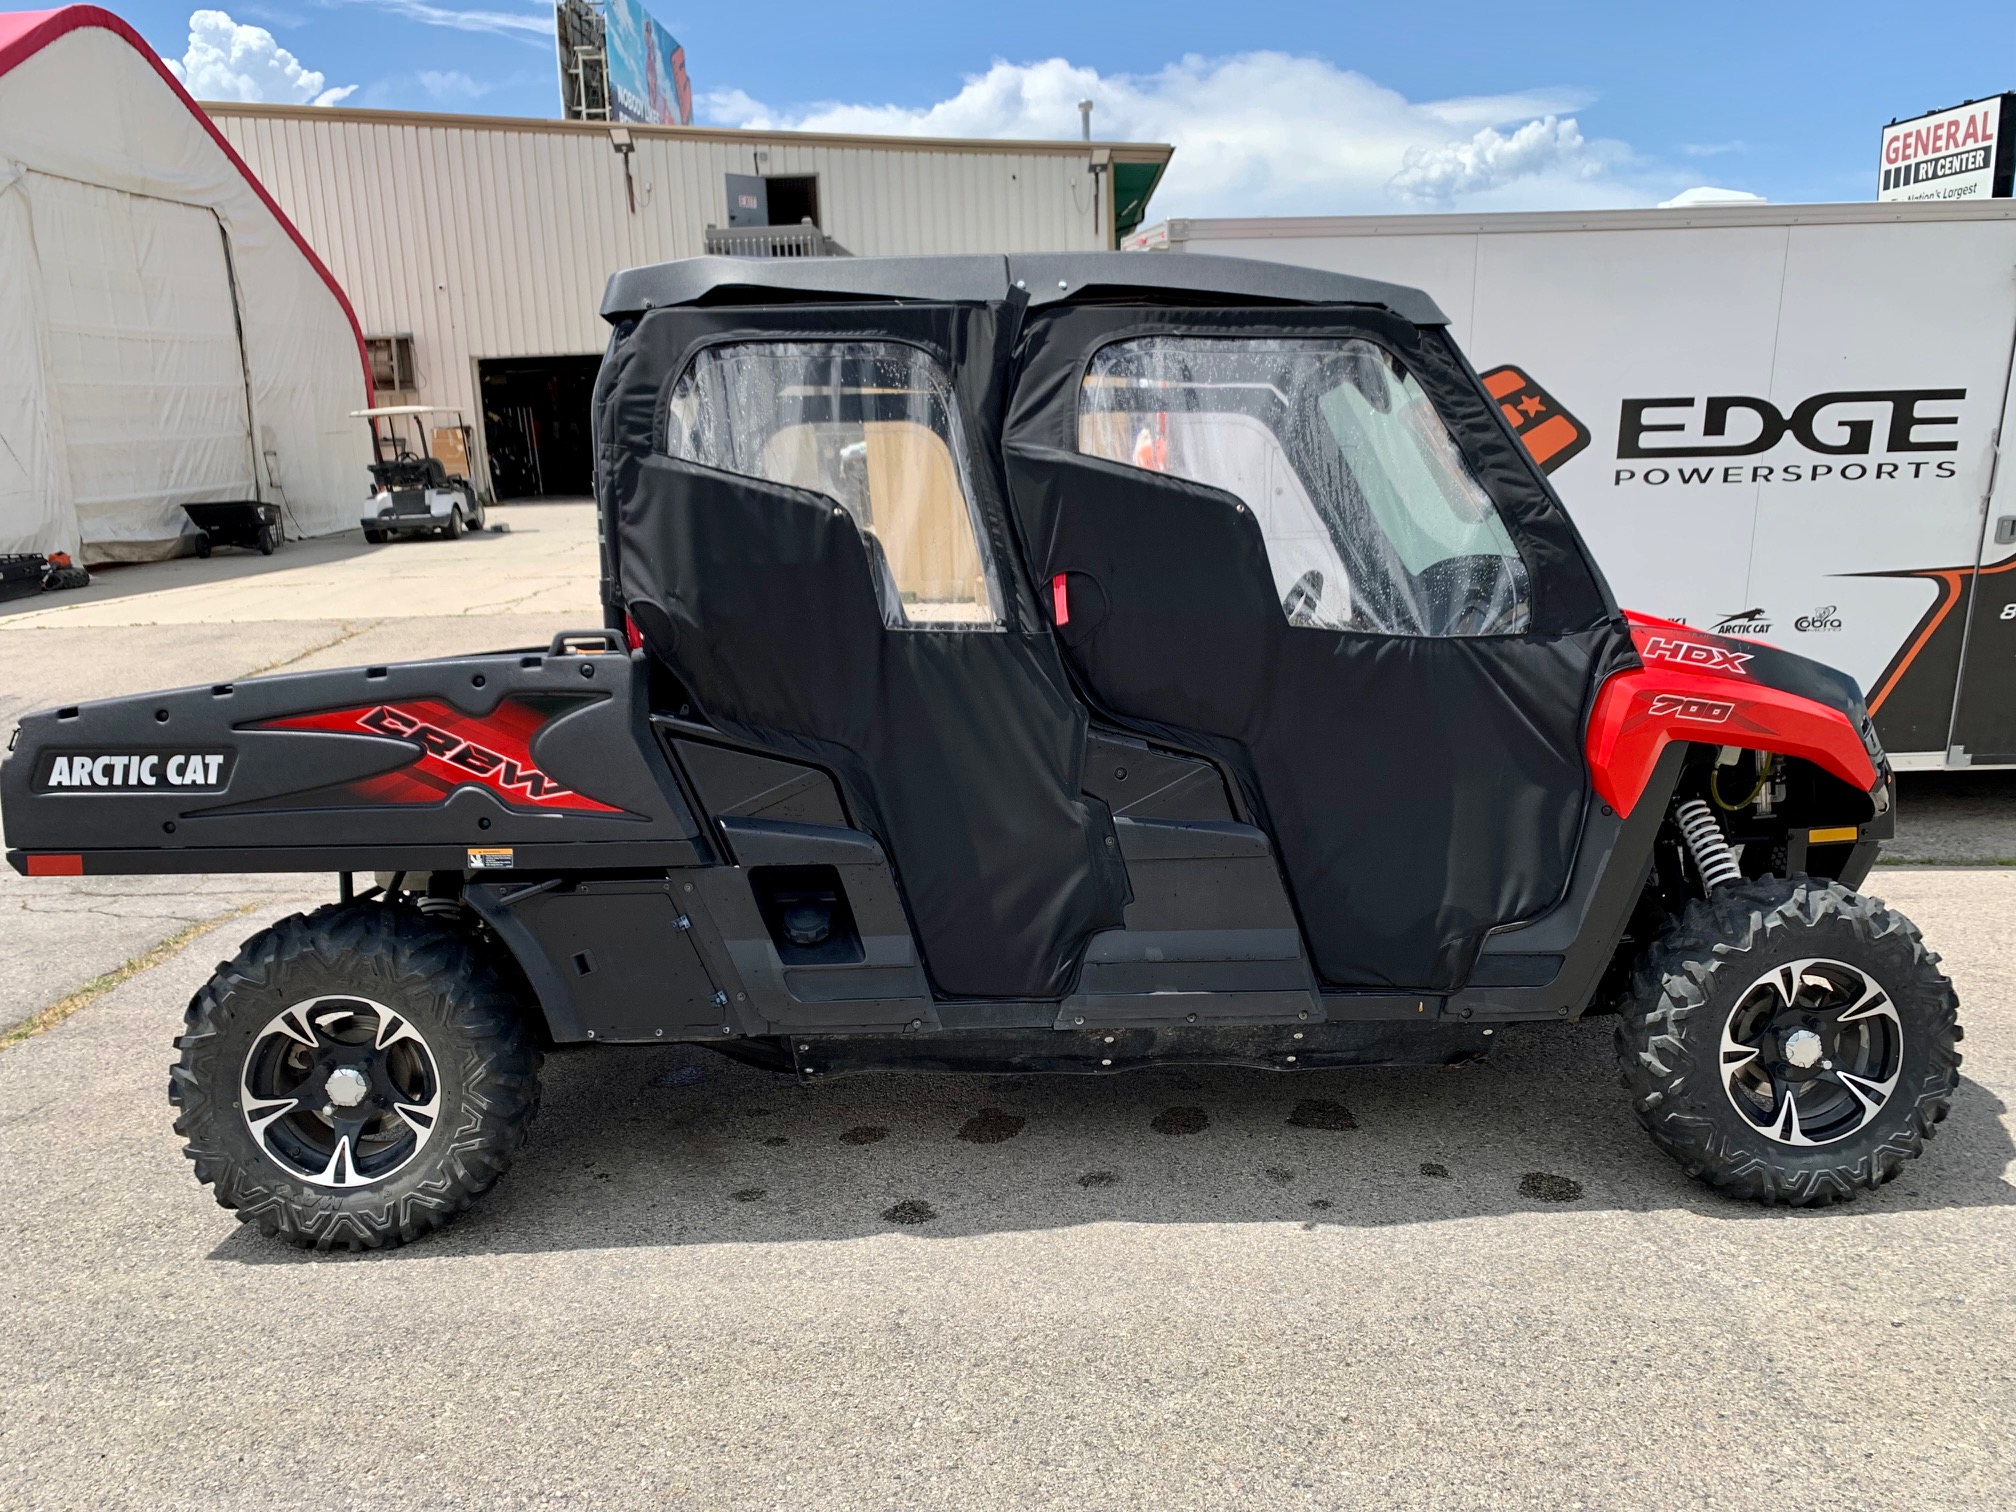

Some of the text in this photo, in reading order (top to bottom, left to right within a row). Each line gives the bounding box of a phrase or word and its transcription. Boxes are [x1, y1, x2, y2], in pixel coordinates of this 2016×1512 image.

[1885, 111, 1994, 165] GENERAL
[1919, 150, 1985, 180] RV CENTER
[1942, 182, 1978, 199] Largest
[1617, 389, 1967, 459] EDGE
[1614, 460, 1957, 486] POWERSPORTS
[1718, 624, 1772, 634] ARCTIC CAT
[1794, 616, 1842, 632] Cobra
[1642, 636, 1755, 675] HDX
[1648, 694, 1735, 723] 700
[356, 705, 573, 800] CREW
[48, 754, 224, 786] ARCTIC CAT
